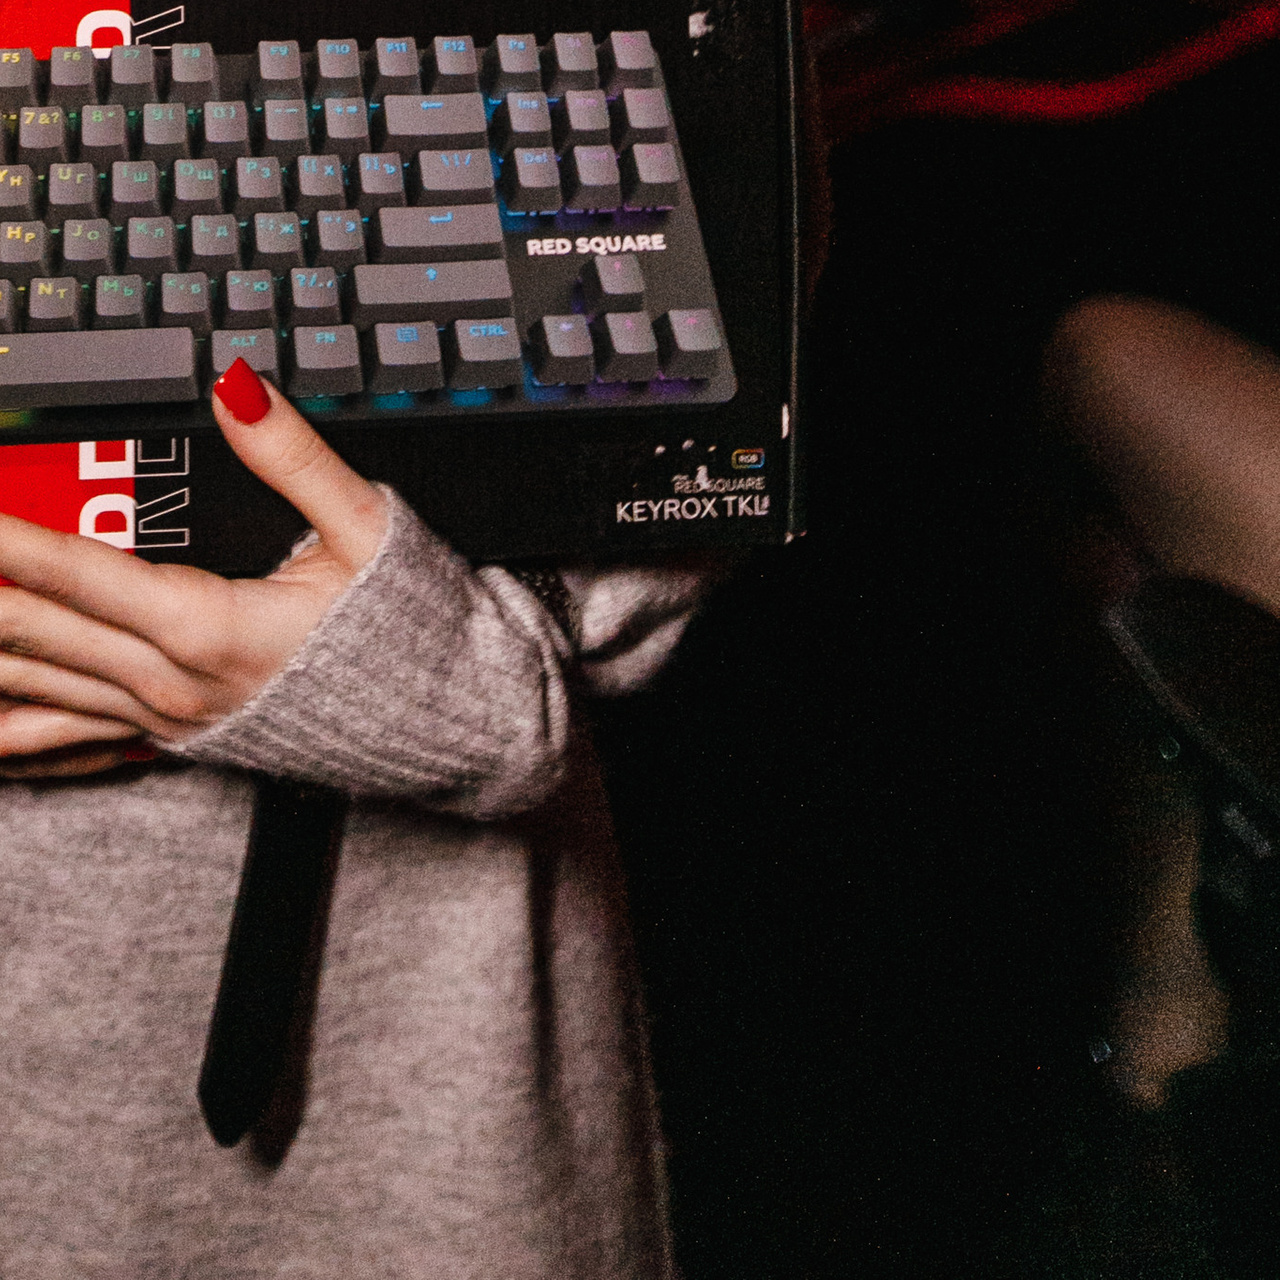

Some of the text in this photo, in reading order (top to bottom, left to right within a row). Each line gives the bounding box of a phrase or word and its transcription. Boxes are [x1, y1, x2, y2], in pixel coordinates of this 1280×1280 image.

[2, 52, 21, 64] F5
[64, 51, 82, 61] F6
[123, 49, 141, 60] F7
[326, 43, 351, 55] F10
[387, 42, 408, 54] F11
[443, 40, 466, 53] F12
[527, 234, 666, 256] RED SQUARE
[229, 335, 258, 347] ALT
[468, 324, 509, 338] CTRL
[616, 495, 770, 523] KEYROX TKL
